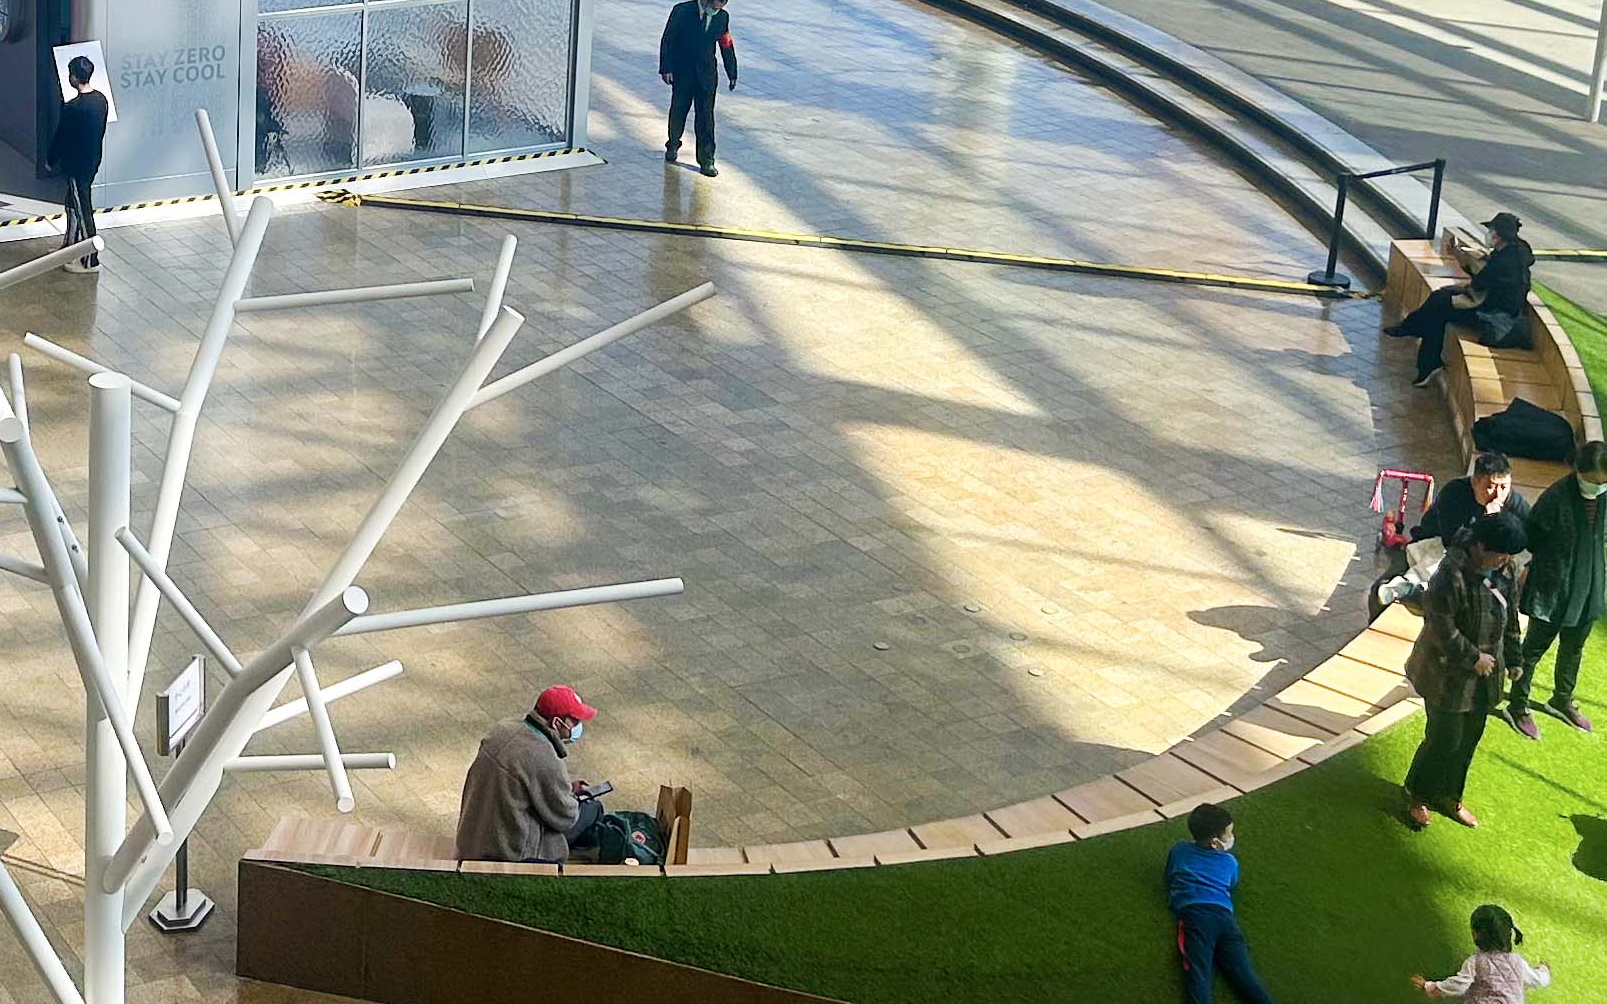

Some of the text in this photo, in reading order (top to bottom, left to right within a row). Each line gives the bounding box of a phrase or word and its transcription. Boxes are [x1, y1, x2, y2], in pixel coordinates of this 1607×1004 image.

[121, 45, 226, 70] STAY ZERO
[120, 64, 226, 89] STAY COOL
